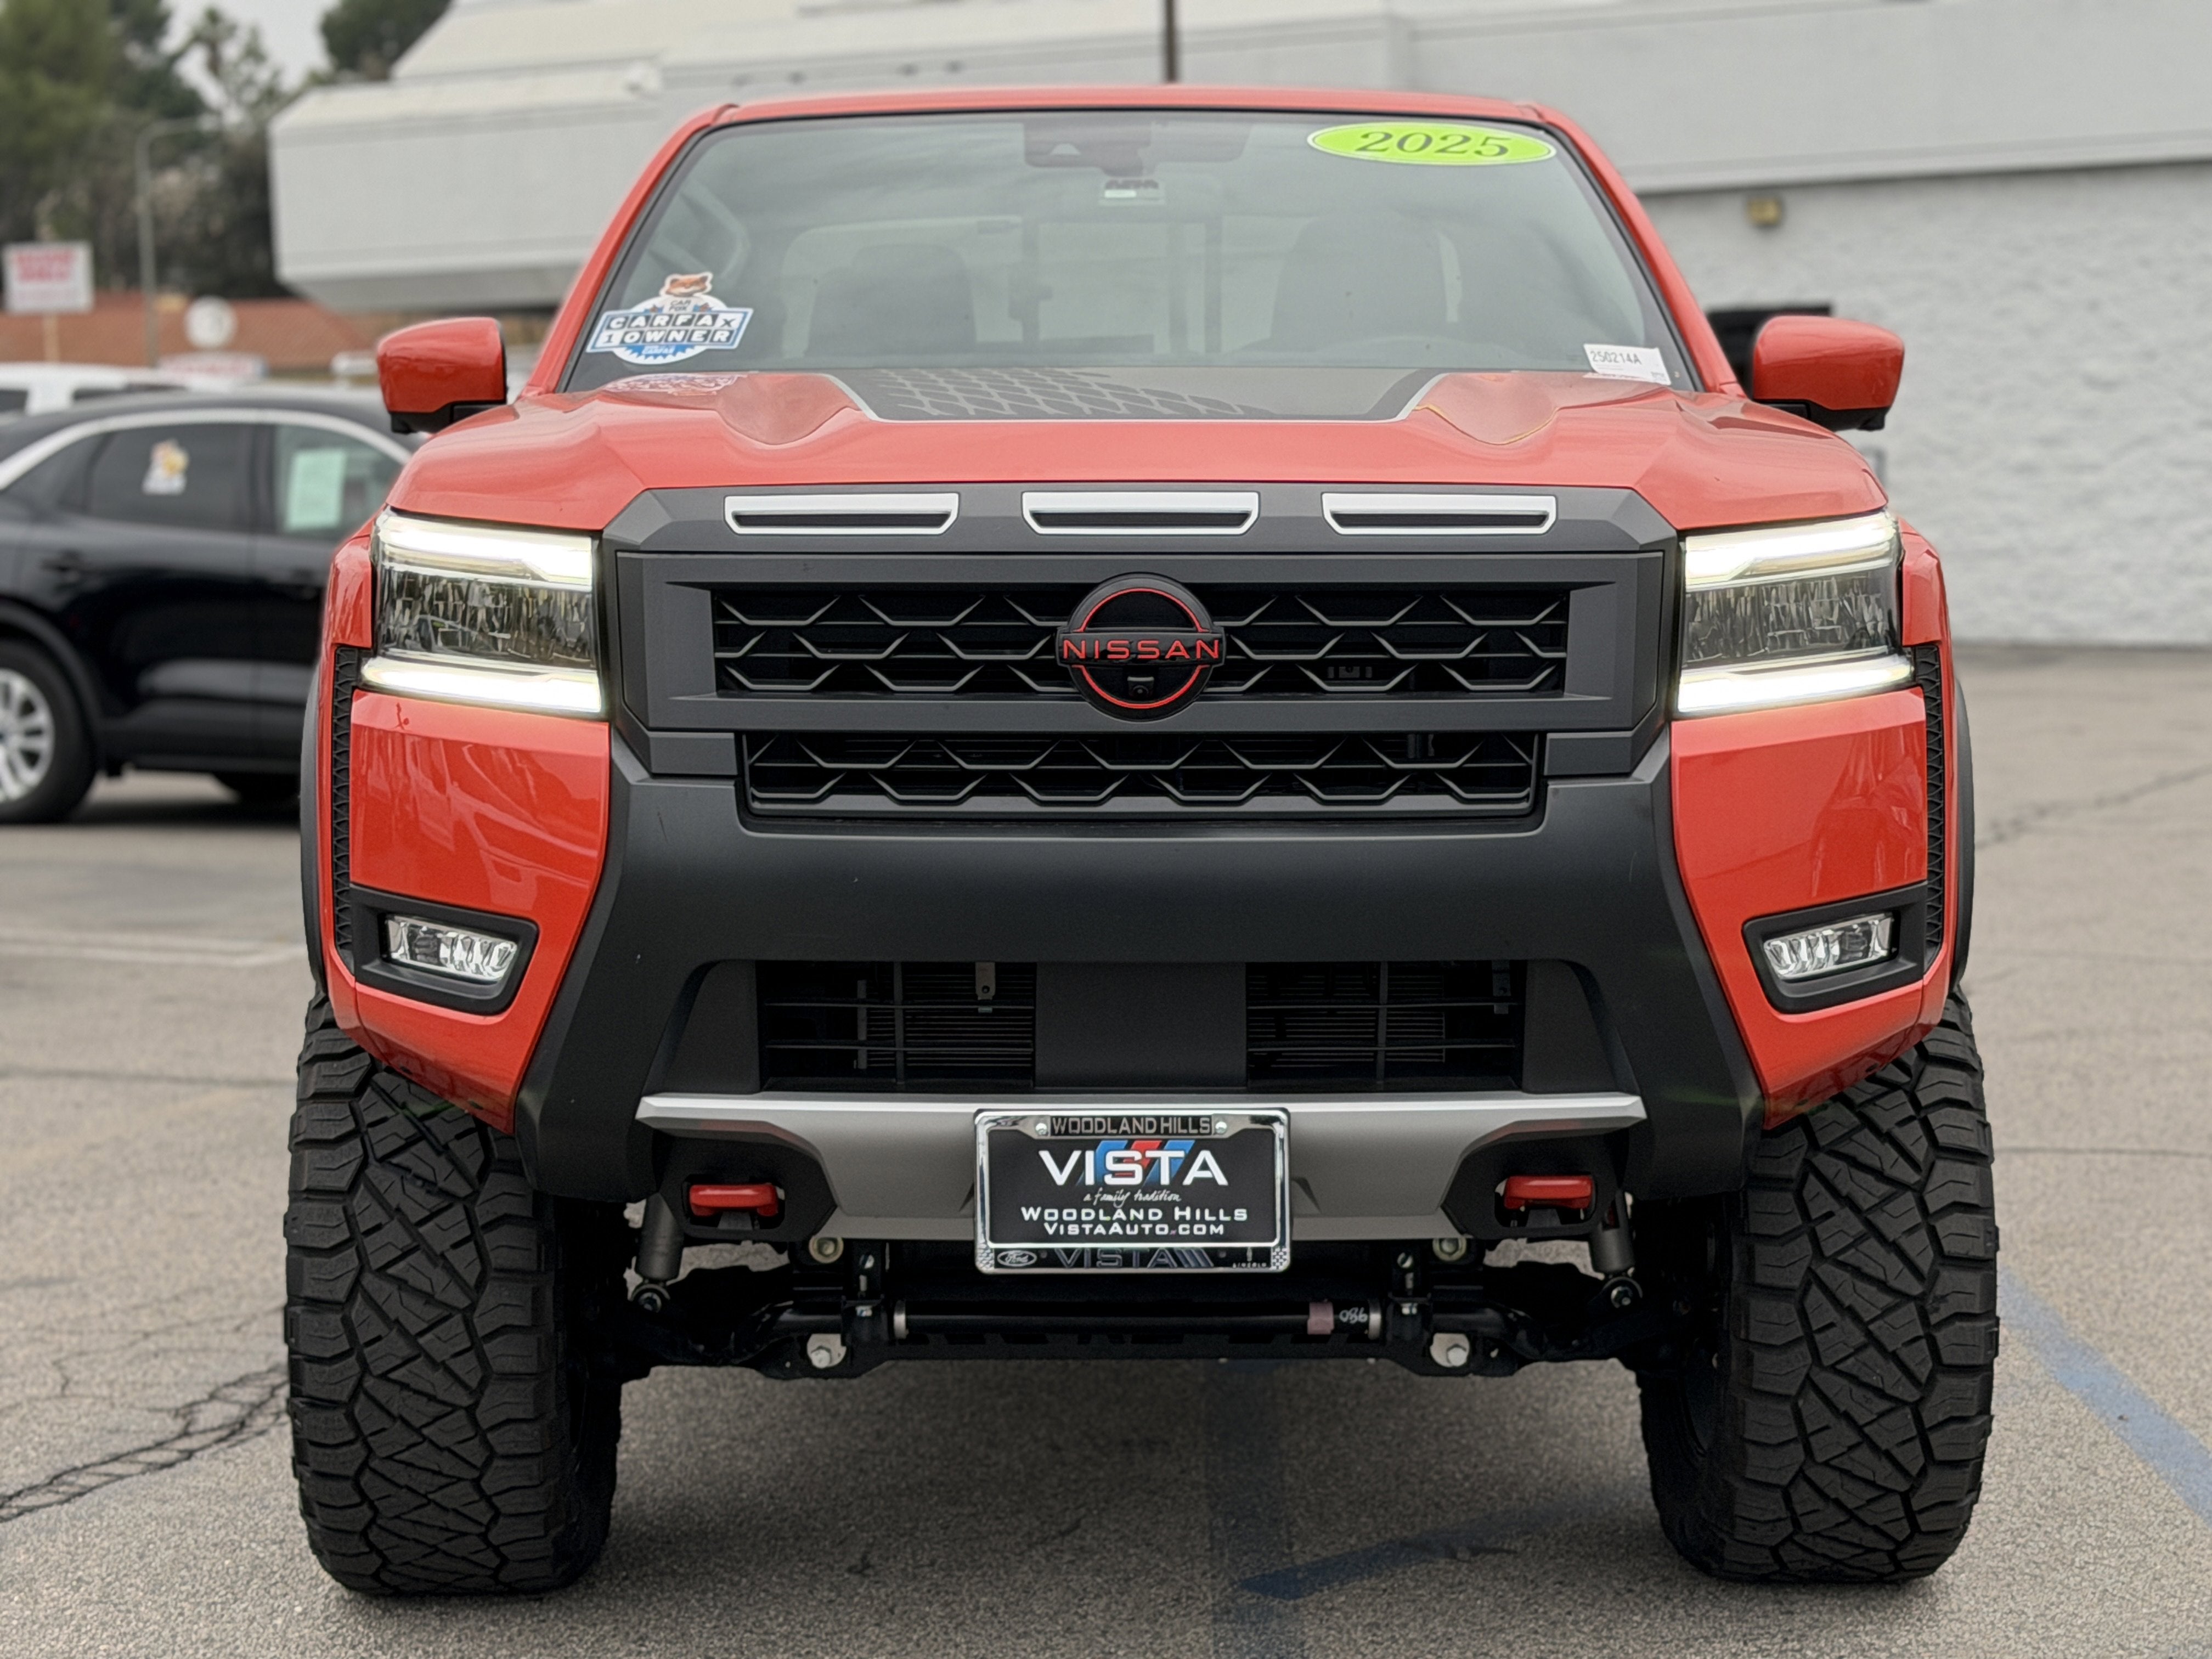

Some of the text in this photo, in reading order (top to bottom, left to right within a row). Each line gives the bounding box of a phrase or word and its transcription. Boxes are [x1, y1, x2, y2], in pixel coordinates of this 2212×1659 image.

[1355, 131, 1512, 157] 2025
[609, 314, 735, 329] CARFAX
[603, 330, 730, 344] 1 OWNER
[1063, 639, 1218, 659] NISSAN
[1052, 1118, 1210, 1134] WOODLAND HILLS
[1038, 1150, 1228, 1186] VISTA
[1093, 1188, 1130, 1207] family
[1133, 1188, 1182, 1203] tradition
[1054, 1248, 1177, 1268] VISTA
